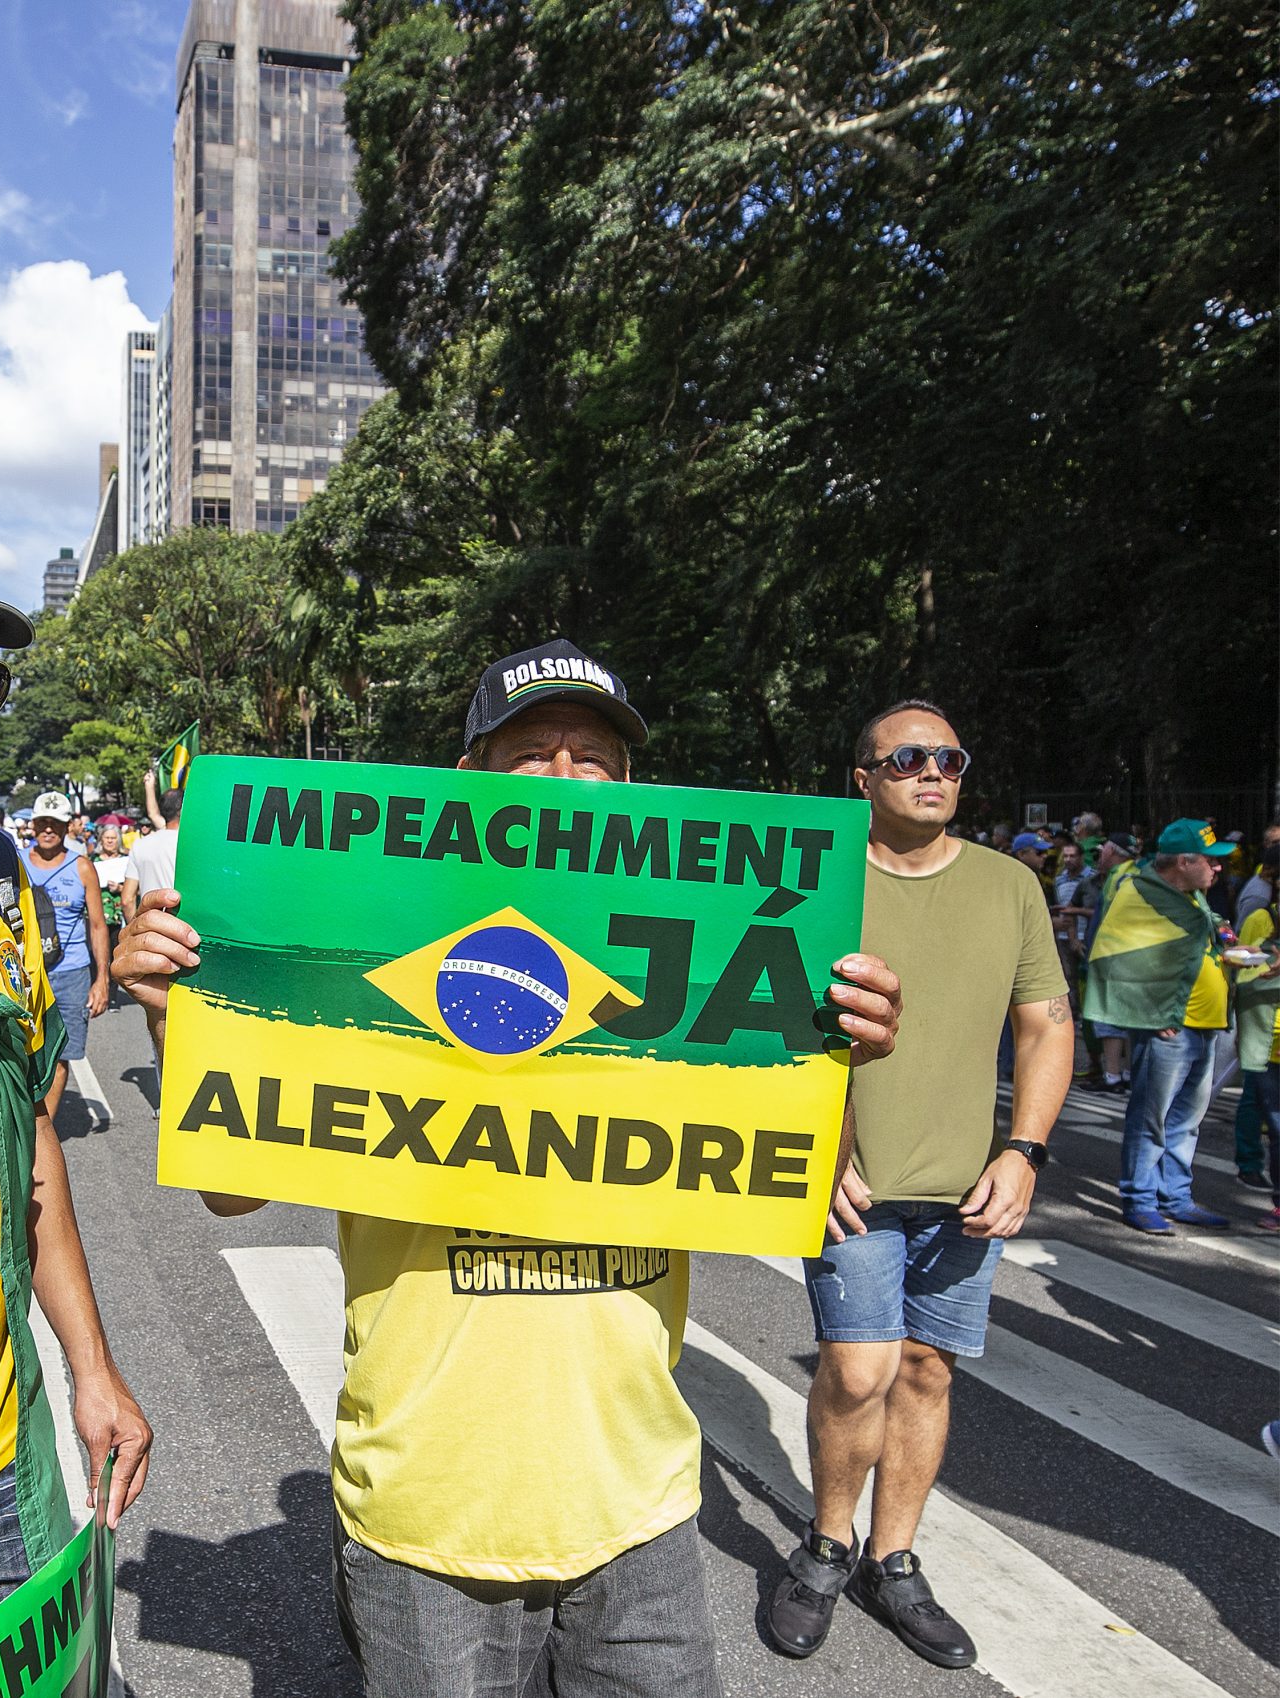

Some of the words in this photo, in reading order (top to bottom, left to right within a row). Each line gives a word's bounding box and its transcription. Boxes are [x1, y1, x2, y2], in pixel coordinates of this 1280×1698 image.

[226, 784, 835, 892] IMPEACHMENT
[443, 960, 485, 972] ORDEM
[489, 965, 497, 975] E
[502, 968, 568, 1012] PROGRESSO
[588, 885, 829, 1055] JÁ
[177, 1070, 816, 1200] ALEXANDRE
[453, 1249, 601, 1292] CONTAGEM
